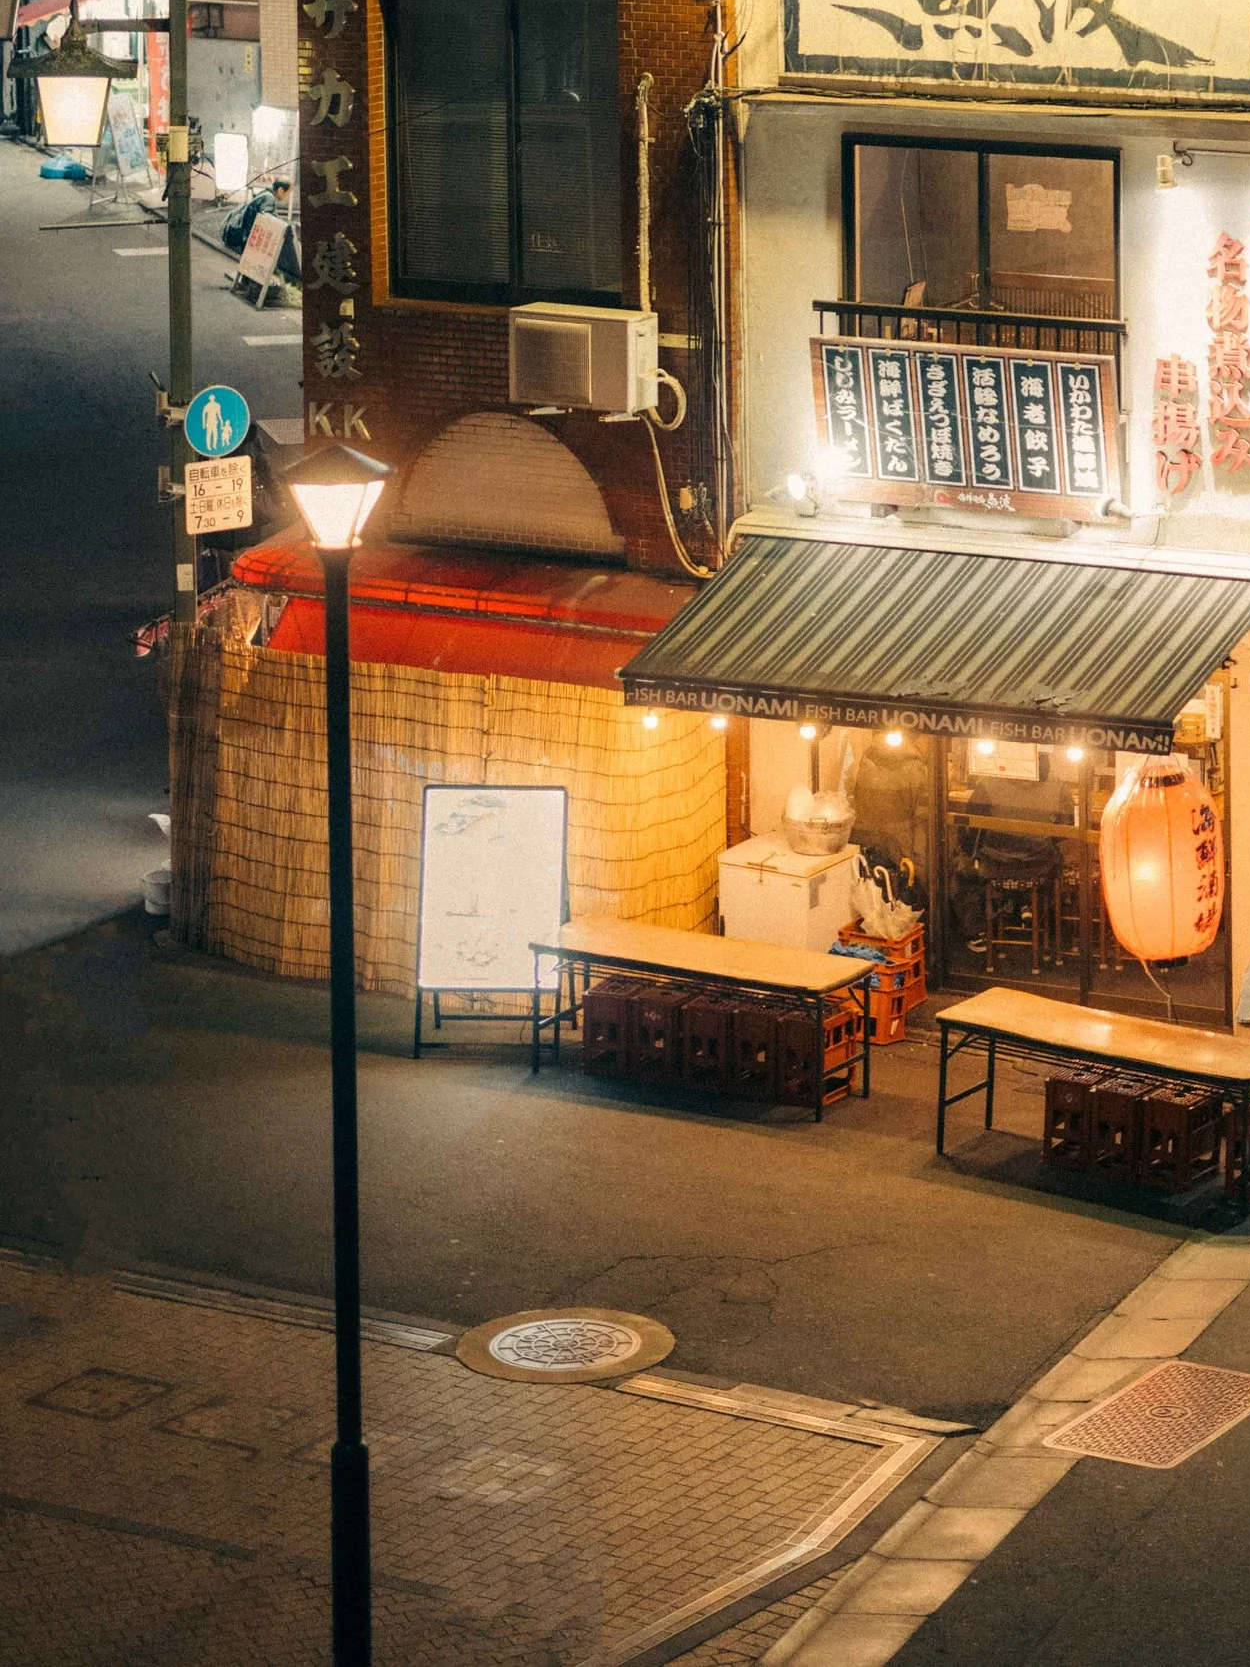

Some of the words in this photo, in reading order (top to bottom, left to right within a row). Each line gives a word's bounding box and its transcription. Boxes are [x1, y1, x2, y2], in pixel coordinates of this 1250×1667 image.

[834, 355, 862, 470] しじみラーメン
[878, 360, 909, 474] 海鮮ばくだん
[926, 363, 955, 477] さざえつぼ焼き
[1152, 352, 1203, 495] 串揚げ
[189, 462, 247, 482] 自転車を除く
[193, 484, 206, 497] 16
[231, 478, 244, 492] 19
[236, 510, 245, 523] 9
[665, 689, 698, 706] BAR
[701, 691, 799, 718] UONAMI
[805, 704, 842, 721] FISH
[846, 707, 879, 724] BAR
[881, 708, 984, 735] UONAMI
[990, 721, 1027, 739] FISH
[1032, 725, 1066, 741] BAR
[1068, 726, 1170, 753] UONAMI
